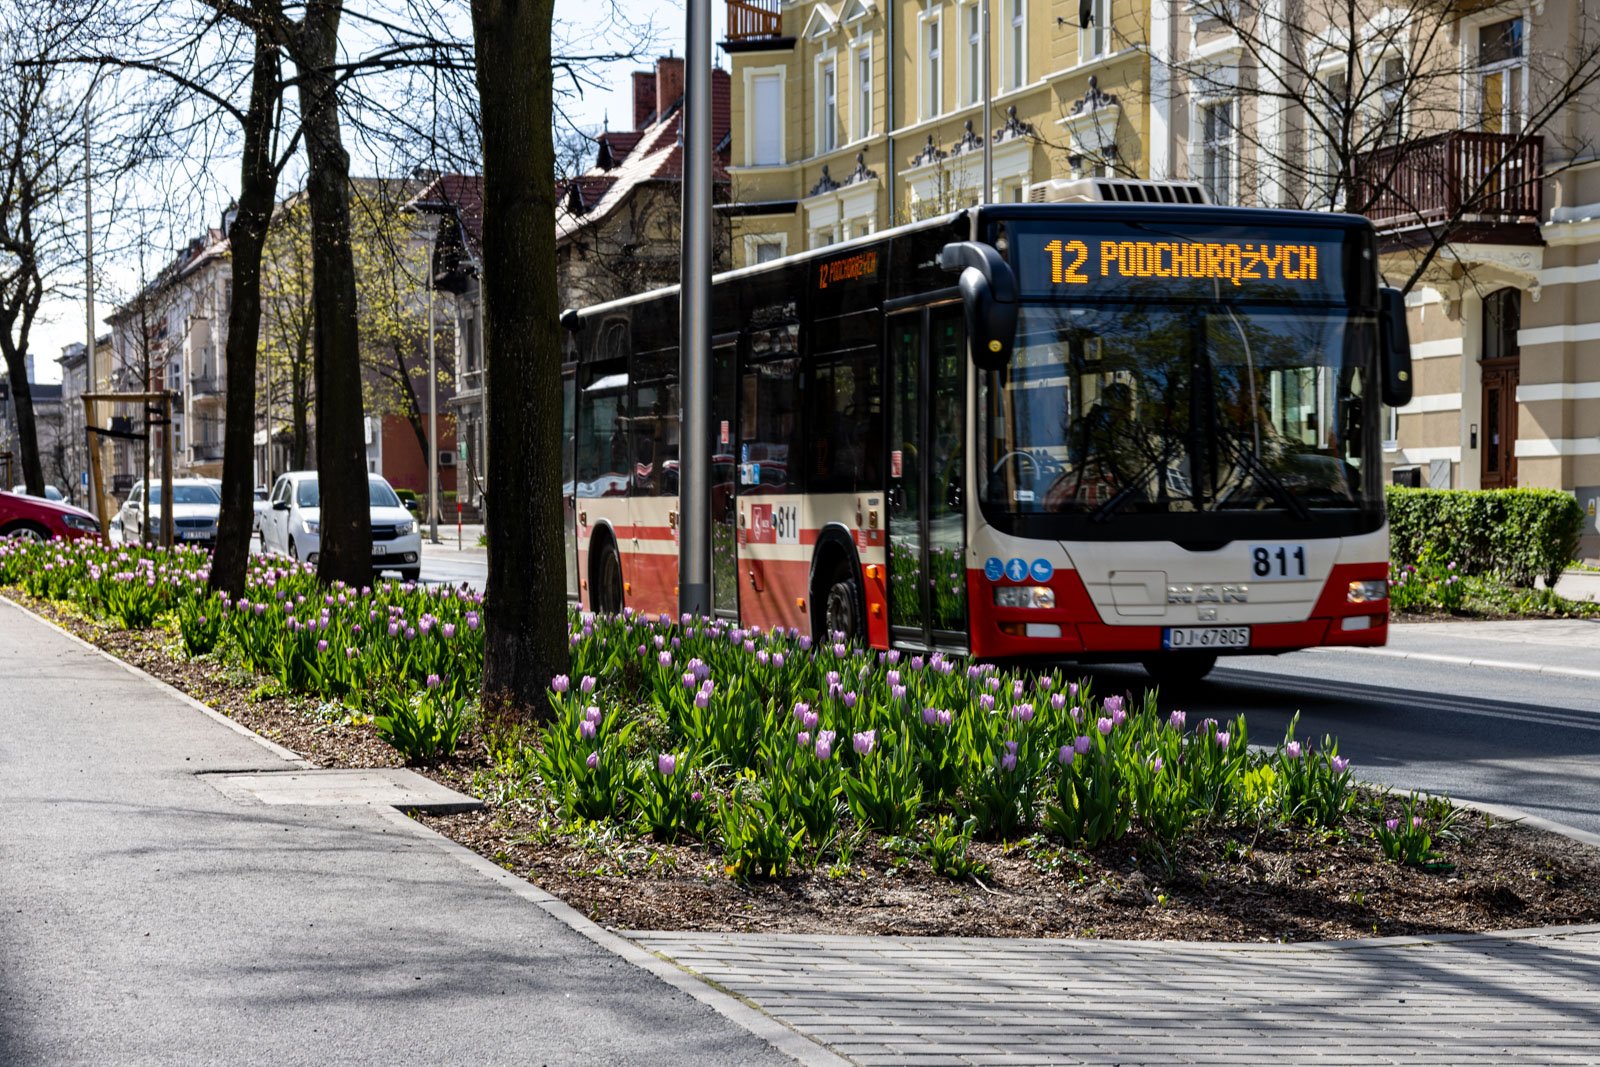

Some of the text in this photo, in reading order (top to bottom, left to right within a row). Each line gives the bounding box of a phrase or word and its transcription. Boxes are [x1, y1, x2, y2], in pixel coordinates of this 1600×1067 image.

[819, 263, 829, 289] 12
[1044, 240, 1318, 286] 12 PODCHORĄŻYCH
[778, 506, 797, 538] 811
[1253, 546, 1306, 577] 811
[1172, 629, 1248, 646] DJ 67805
